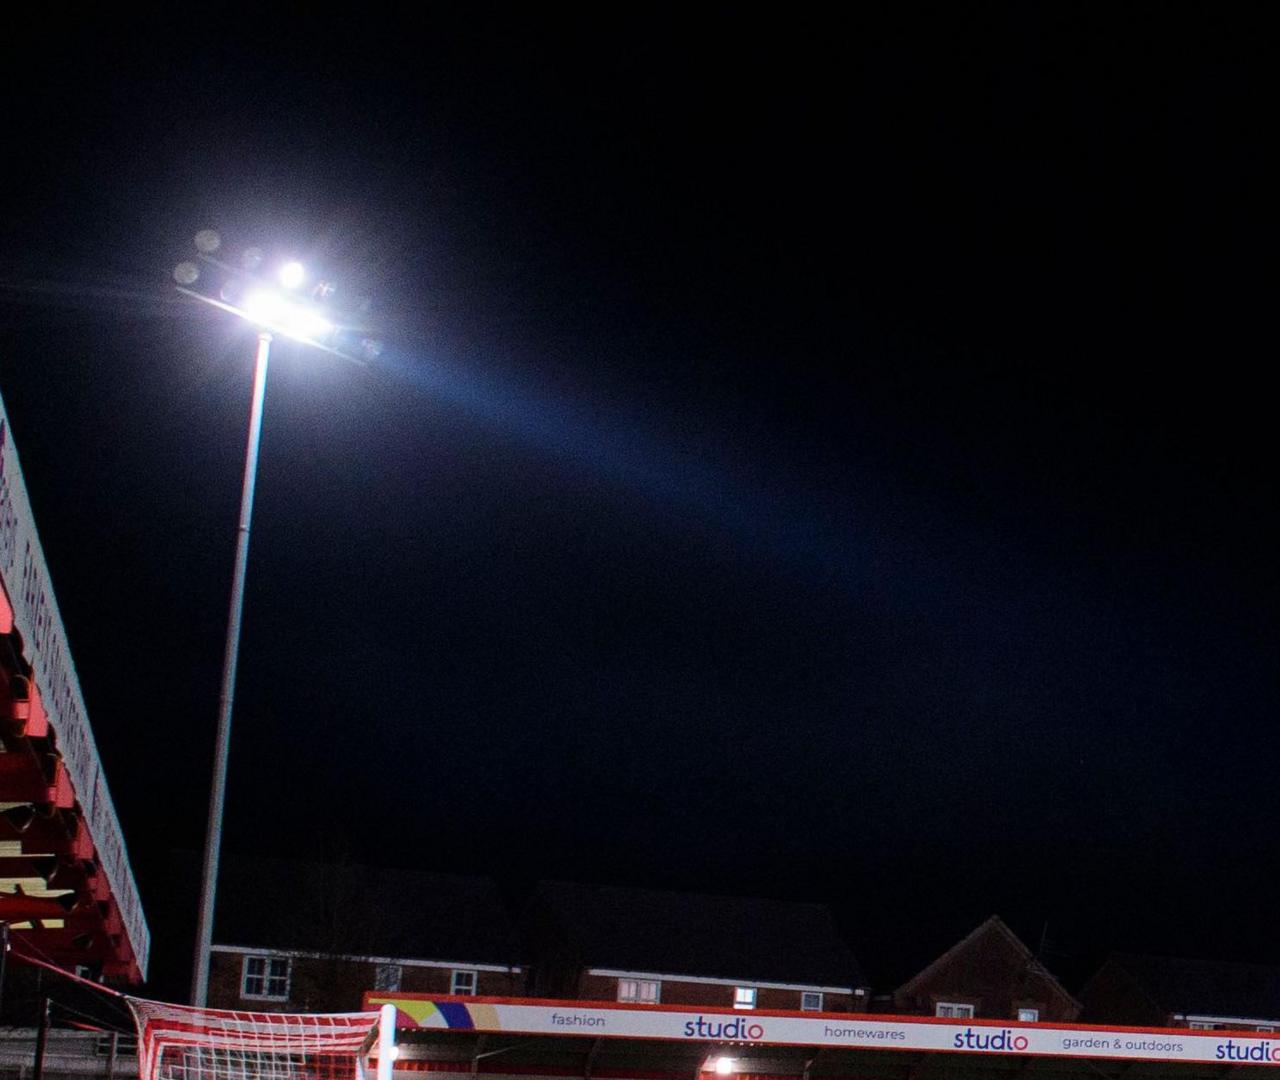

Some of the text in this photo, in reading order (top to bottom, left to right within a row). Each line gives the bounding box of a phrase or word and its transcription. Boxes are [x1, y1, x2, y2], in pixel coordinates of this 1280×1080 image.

[552, 1012, 605, 1028] fashion
[684, 1016, 763, 1040] studio
[824, 1026, 905, 1041] homewares
[954, 1028, 1028, 1051] studio
[1062, 1037, 1184, 1053] garden & outdoors
